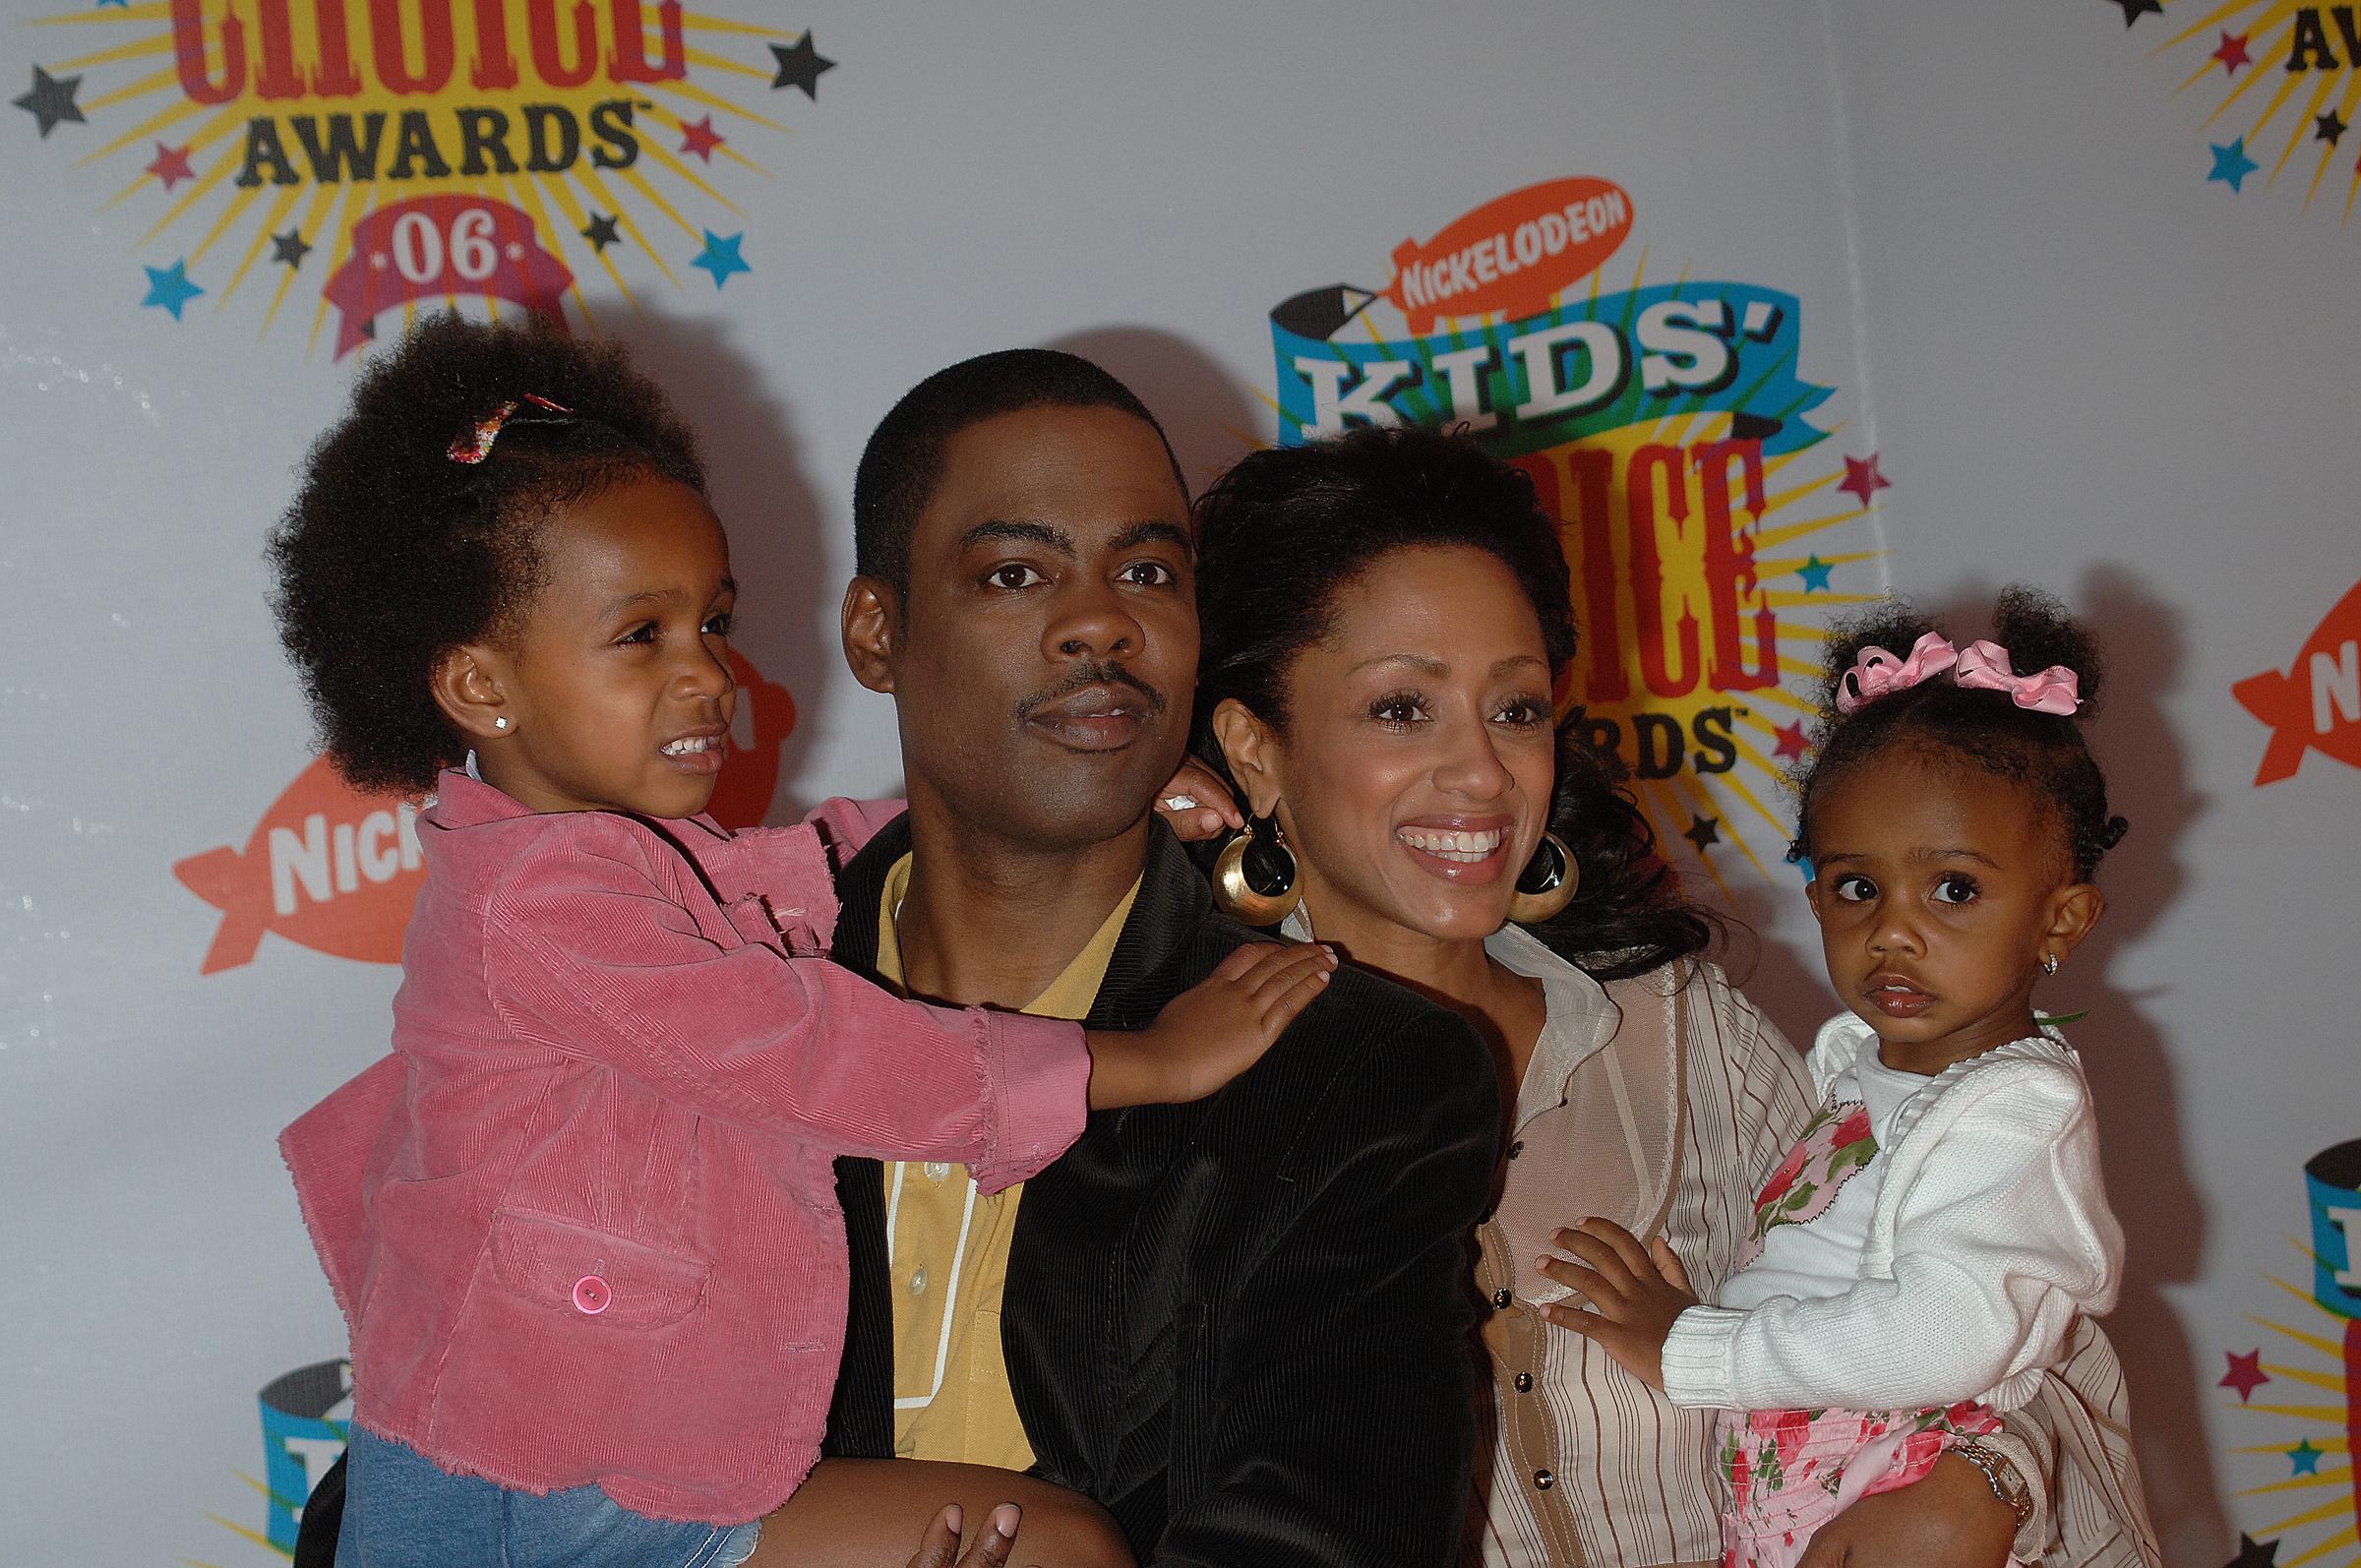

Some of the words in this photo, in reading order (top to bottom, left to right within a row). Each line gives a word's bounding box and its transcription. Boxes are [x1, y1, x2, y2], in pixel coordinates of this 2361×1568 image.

[393, 209, 498, 285] 06
[1402, 192, 1625, 311] NICKELODEON
[1295, 298, 1772, 440] KIDS'
